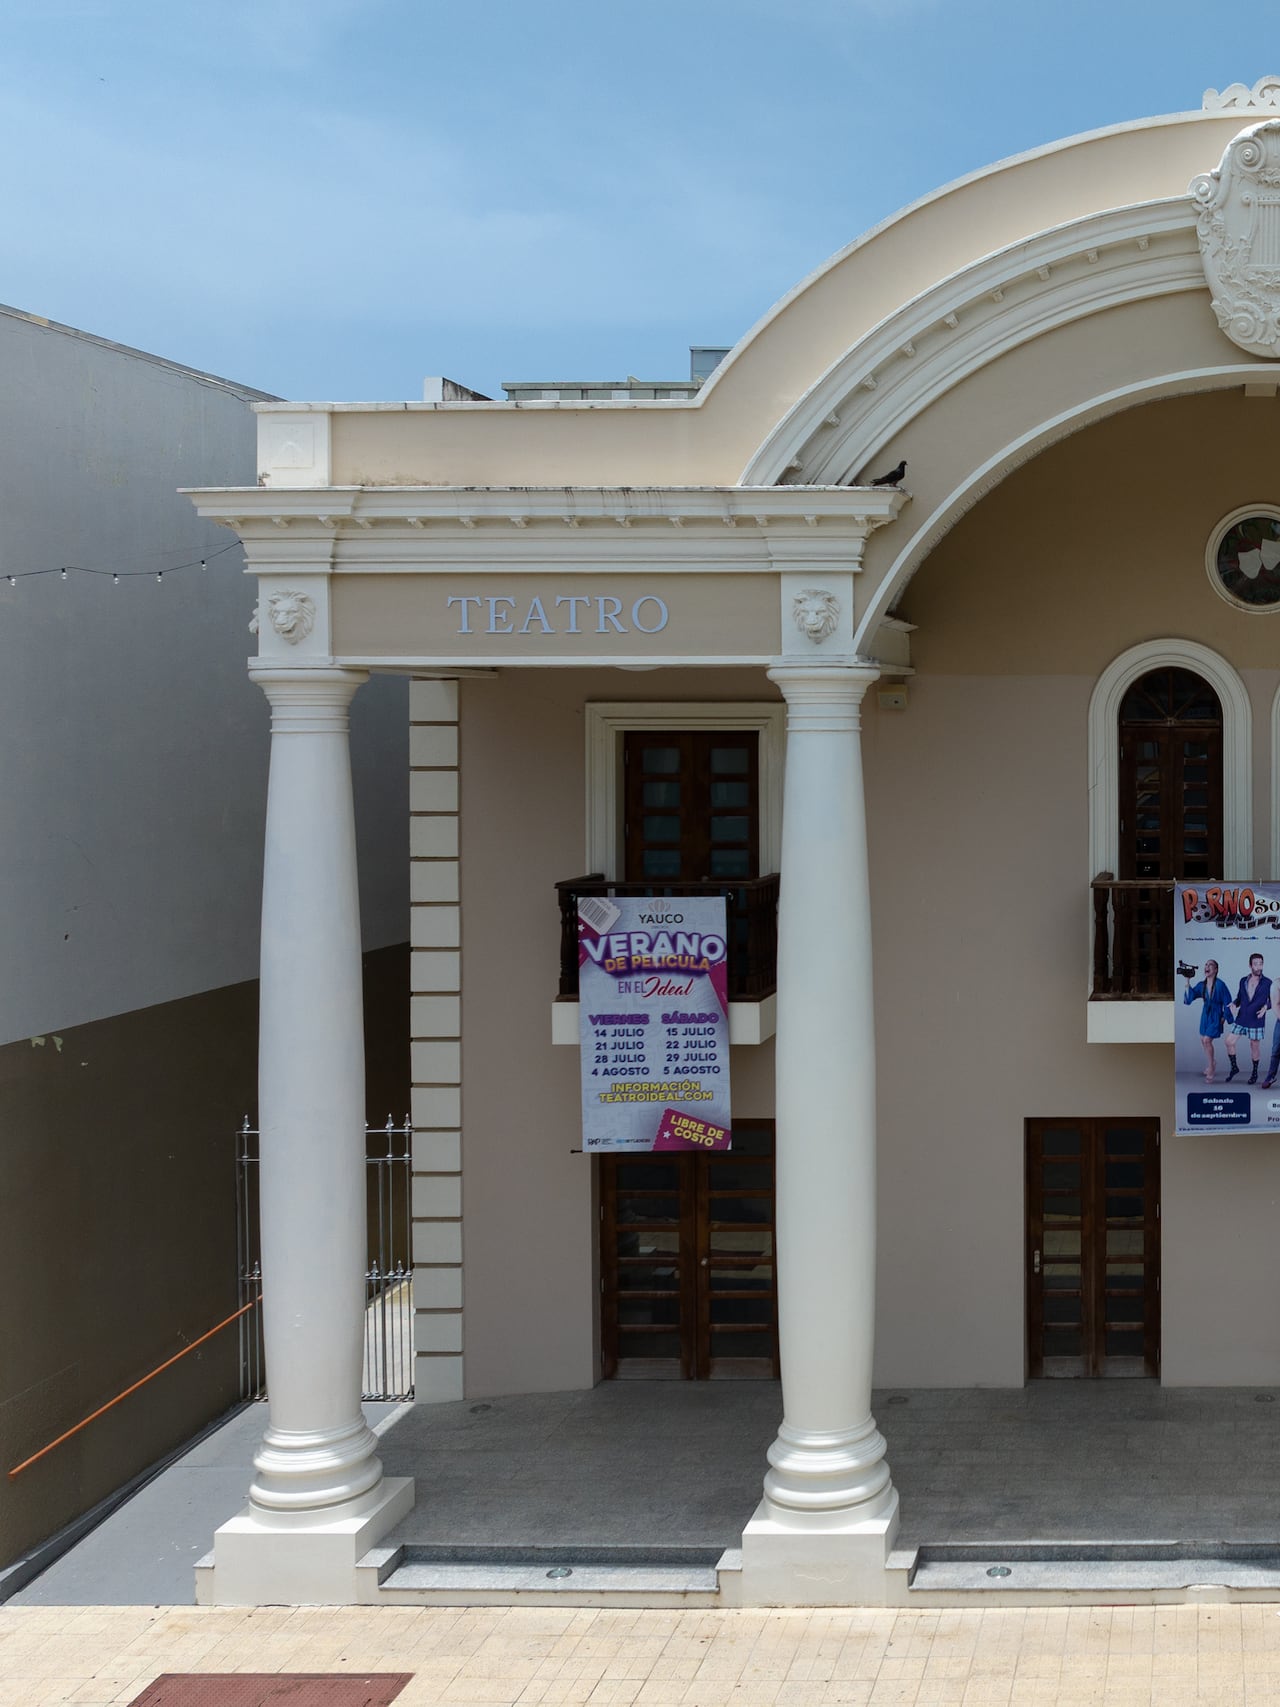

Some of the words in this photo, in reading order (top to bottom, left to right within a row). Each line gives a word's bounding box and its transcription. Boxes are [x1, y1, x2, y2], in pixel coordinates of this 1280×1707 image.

[447, 596, 669, 634] TEATRO
[638, 914, 684, 924] YAUCO
[582, 931, 726, 962] VERANO
[604, 957, 627, 972] DE
[618, 981, 632, 994] EN
[634, 981, 647, 994] EL
[642, 976, 694, 998] Ideal
[588, 1013, 650, 1026] VIERNES
[661, 1010, 720, 1025] SÁBADO
[594, 1029, 607, 1037] 14
[611, 1028, 645, 1037] JULIO
[666, 1028, 678, 1036] 15
[682, 1027, 716, 1036] JULIO
[595, 1042, 607, 1050] 21
[611, 1041, 645, 1050] JULIO
[666, 1041, 679, 1049] 22
[683, 1040, 717, 1049] JULIO
[595, 1055, 608, 1064] 28
[612, 1054, 646, 1063] JULIO
[666, 1053, 680, 1062] 29
[684, 1053, 717, 1062] JULIO
[591, 1068, 599, 1076] 4
[602, 1067, 650, 1076] AGOSTO
[663, 1066, 670, 1075] 5
[673, 1065, 721, 1075] AGOSTO
[611, 1079, 700, 1092] INFORMACIÓN
[599, 1091, 713, 1103] TEATROIDEAL.COM
[670, 1115, 705, 1134] LIBRE
[707, 1127, 724, 1140] DE
[674, 1127, 714, 1147] COSTO
